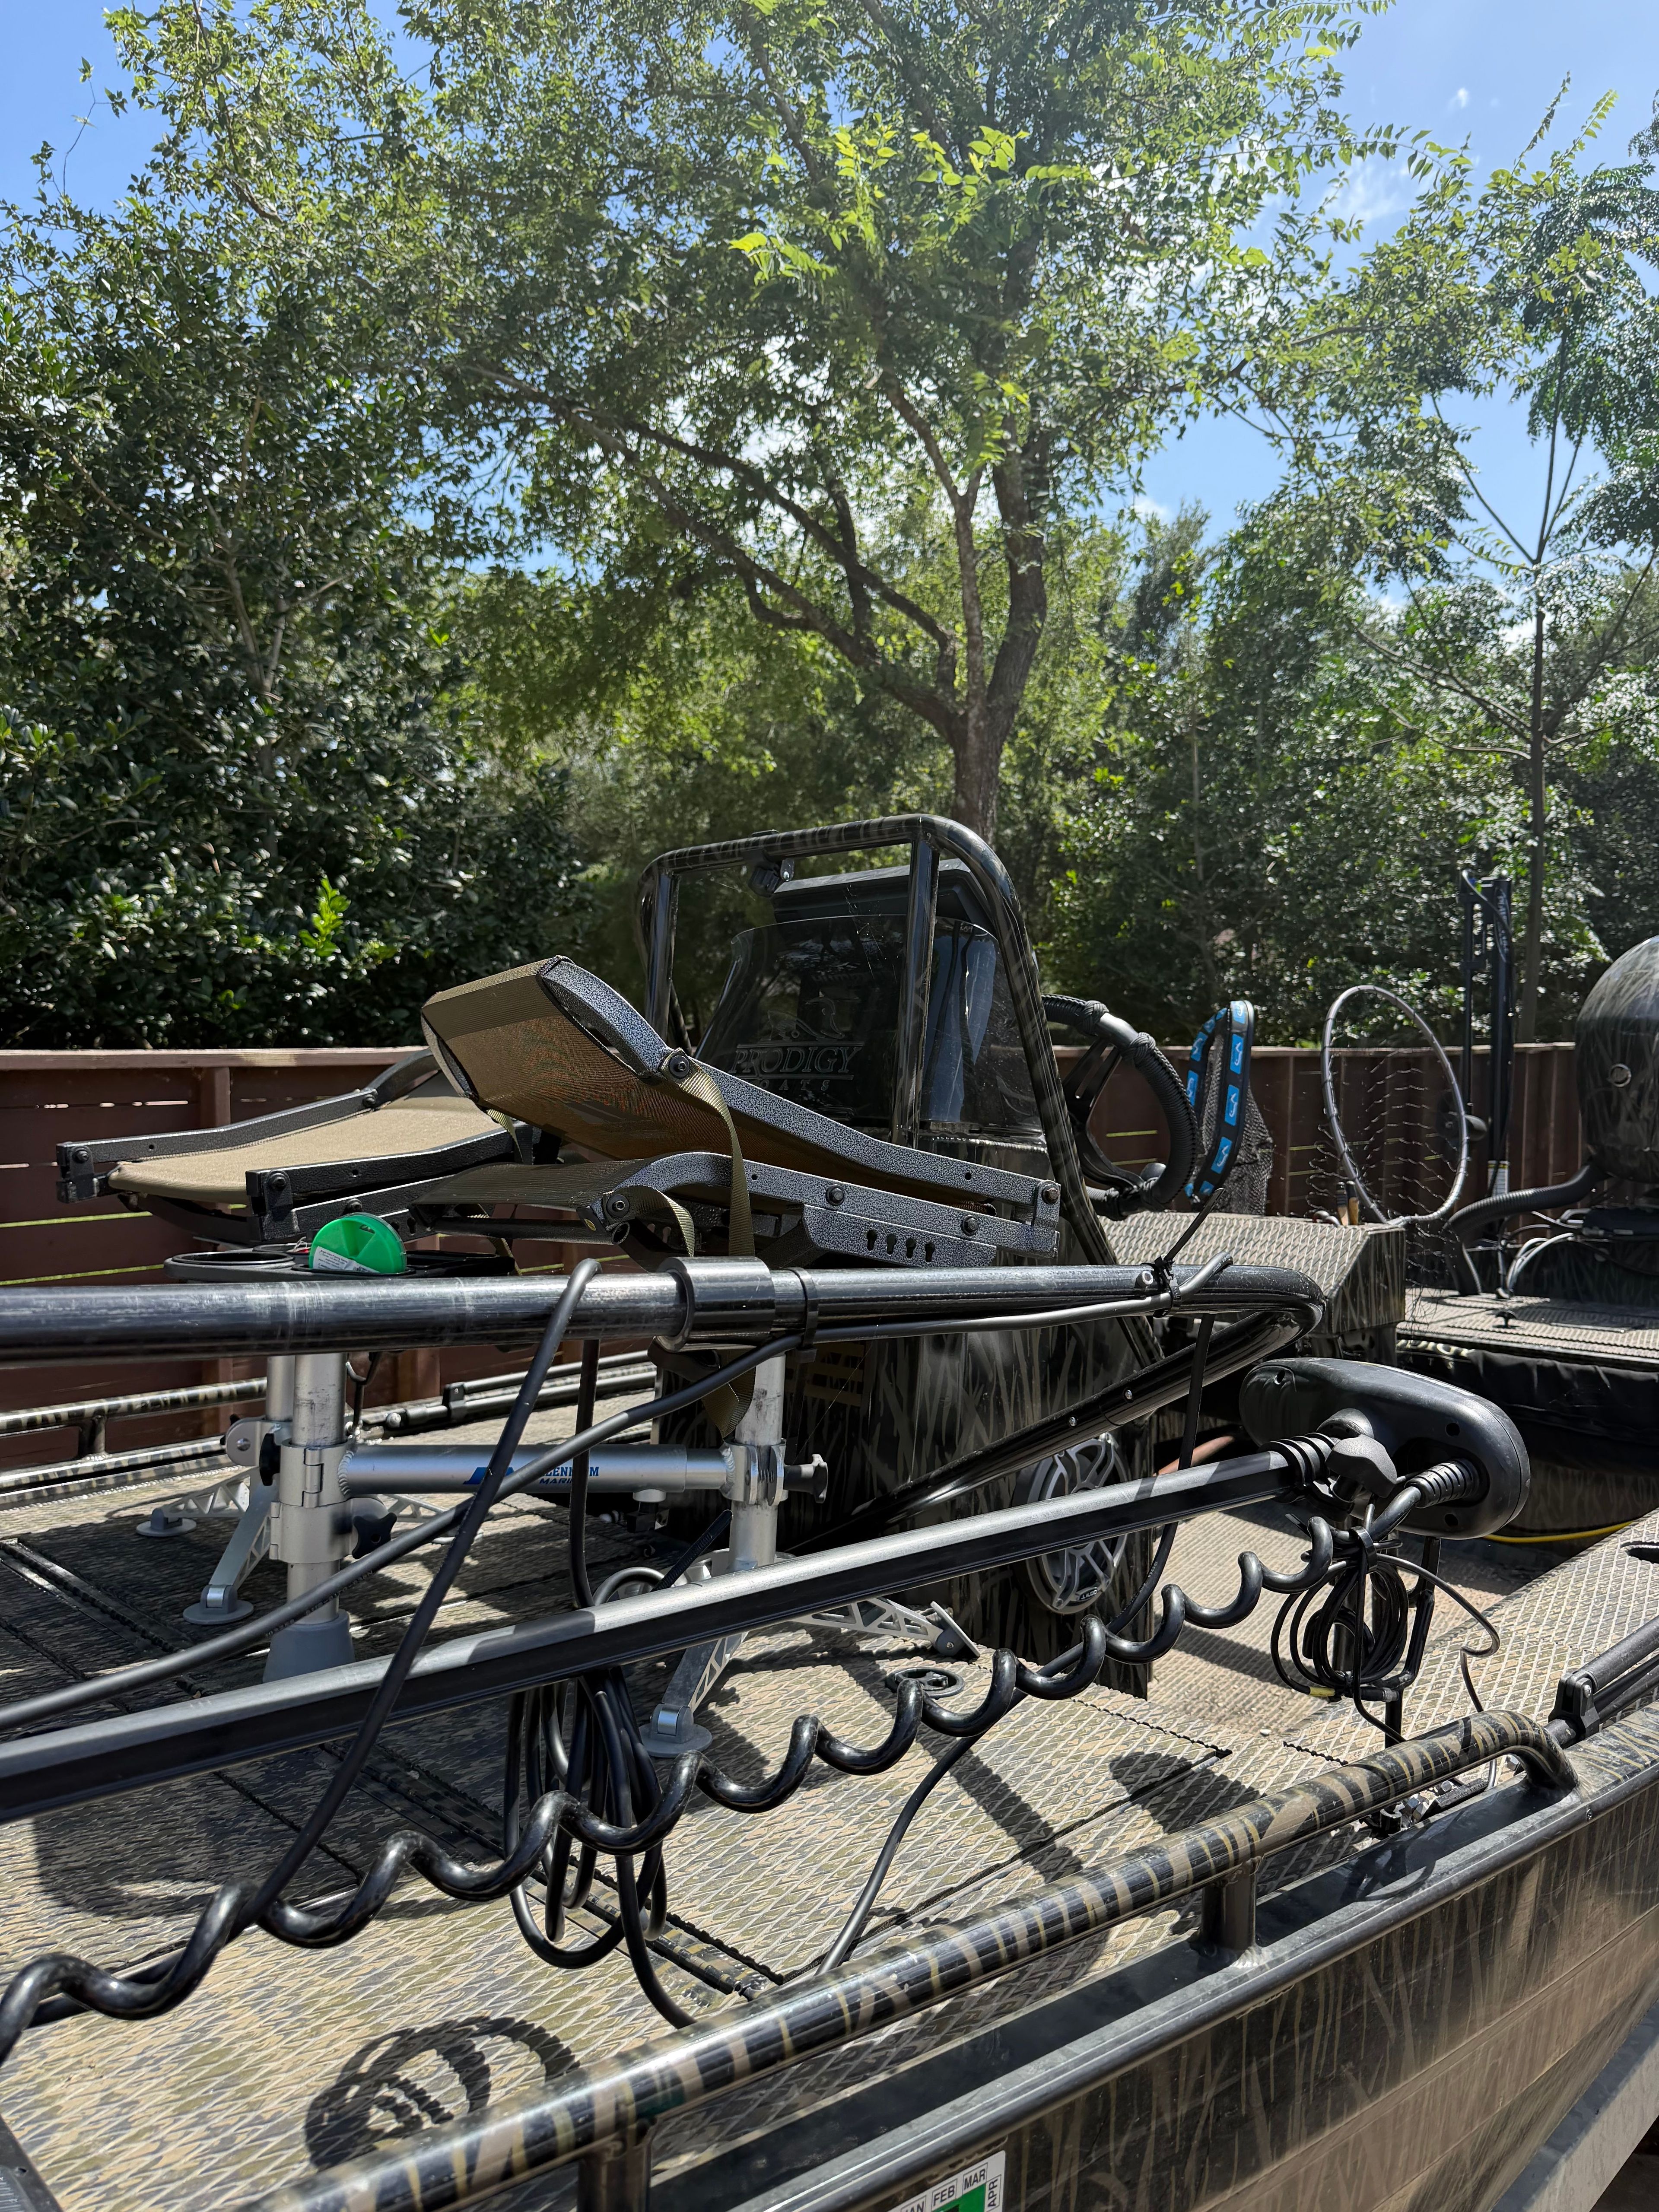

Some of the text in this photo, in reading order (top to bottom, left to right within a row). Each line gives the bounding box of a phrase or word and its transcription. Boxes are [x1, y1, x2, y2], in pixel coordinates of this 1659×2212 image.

[729, 1047, 862, 1076] PRODIGY
[759, 1079, 830, 1091] OATS
[933, 2185, 955, 2207] FEB
[964, 2168, 986, 2190] MAR
[987, 2178, 998, 2208] APR
